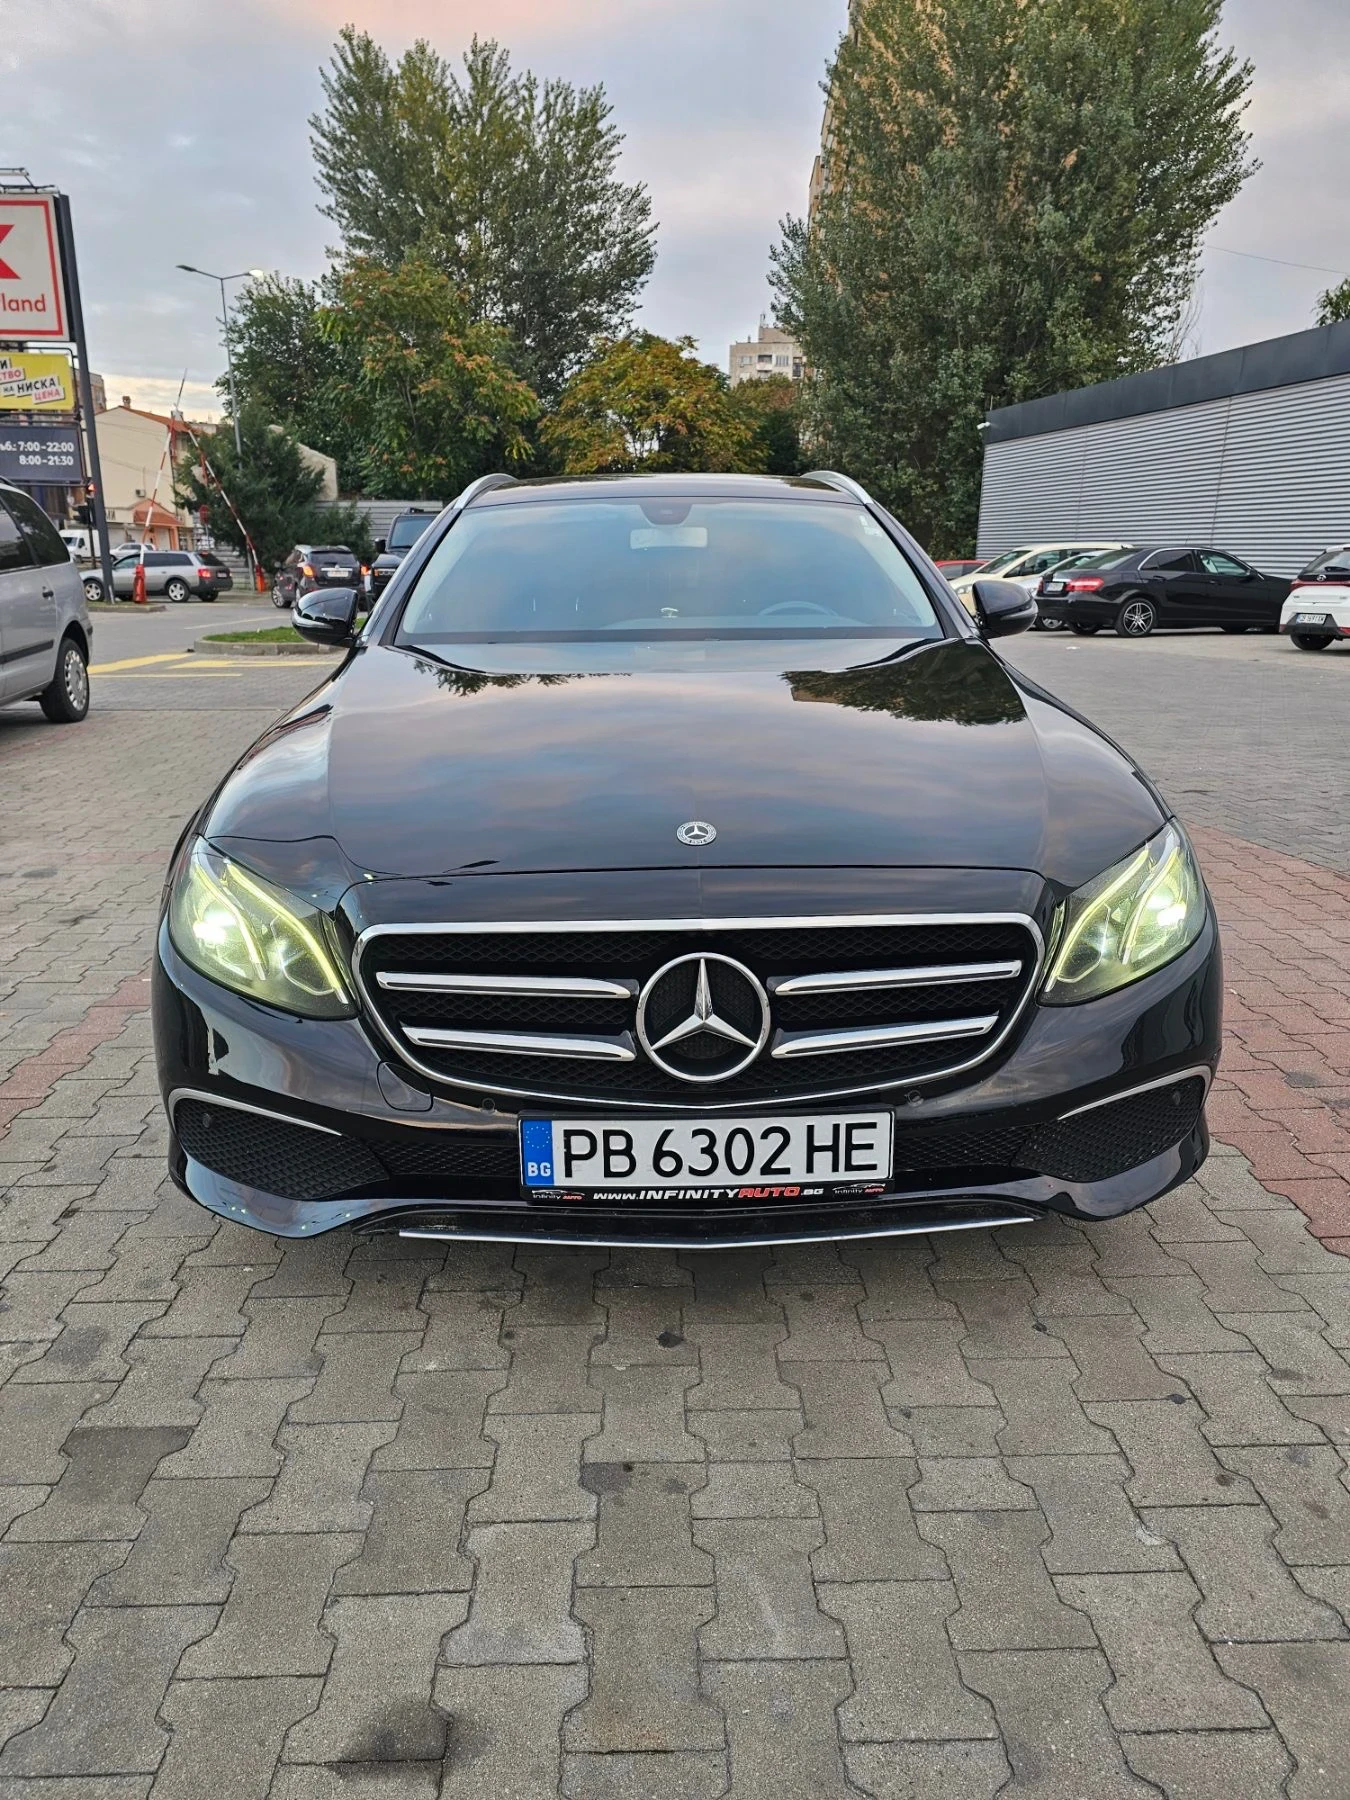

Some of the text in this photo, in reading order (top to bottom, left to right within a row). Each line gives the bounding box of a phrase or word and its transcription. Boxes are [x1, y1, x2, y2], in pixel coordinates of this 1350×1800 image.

[17, 377, 56, 393] НИСКА
[34, 388, 61, 401] ЦЕНА
[563, 1121, 878, 1178] PB 6302 HE
[527, 1161, 551, 1177] BG
